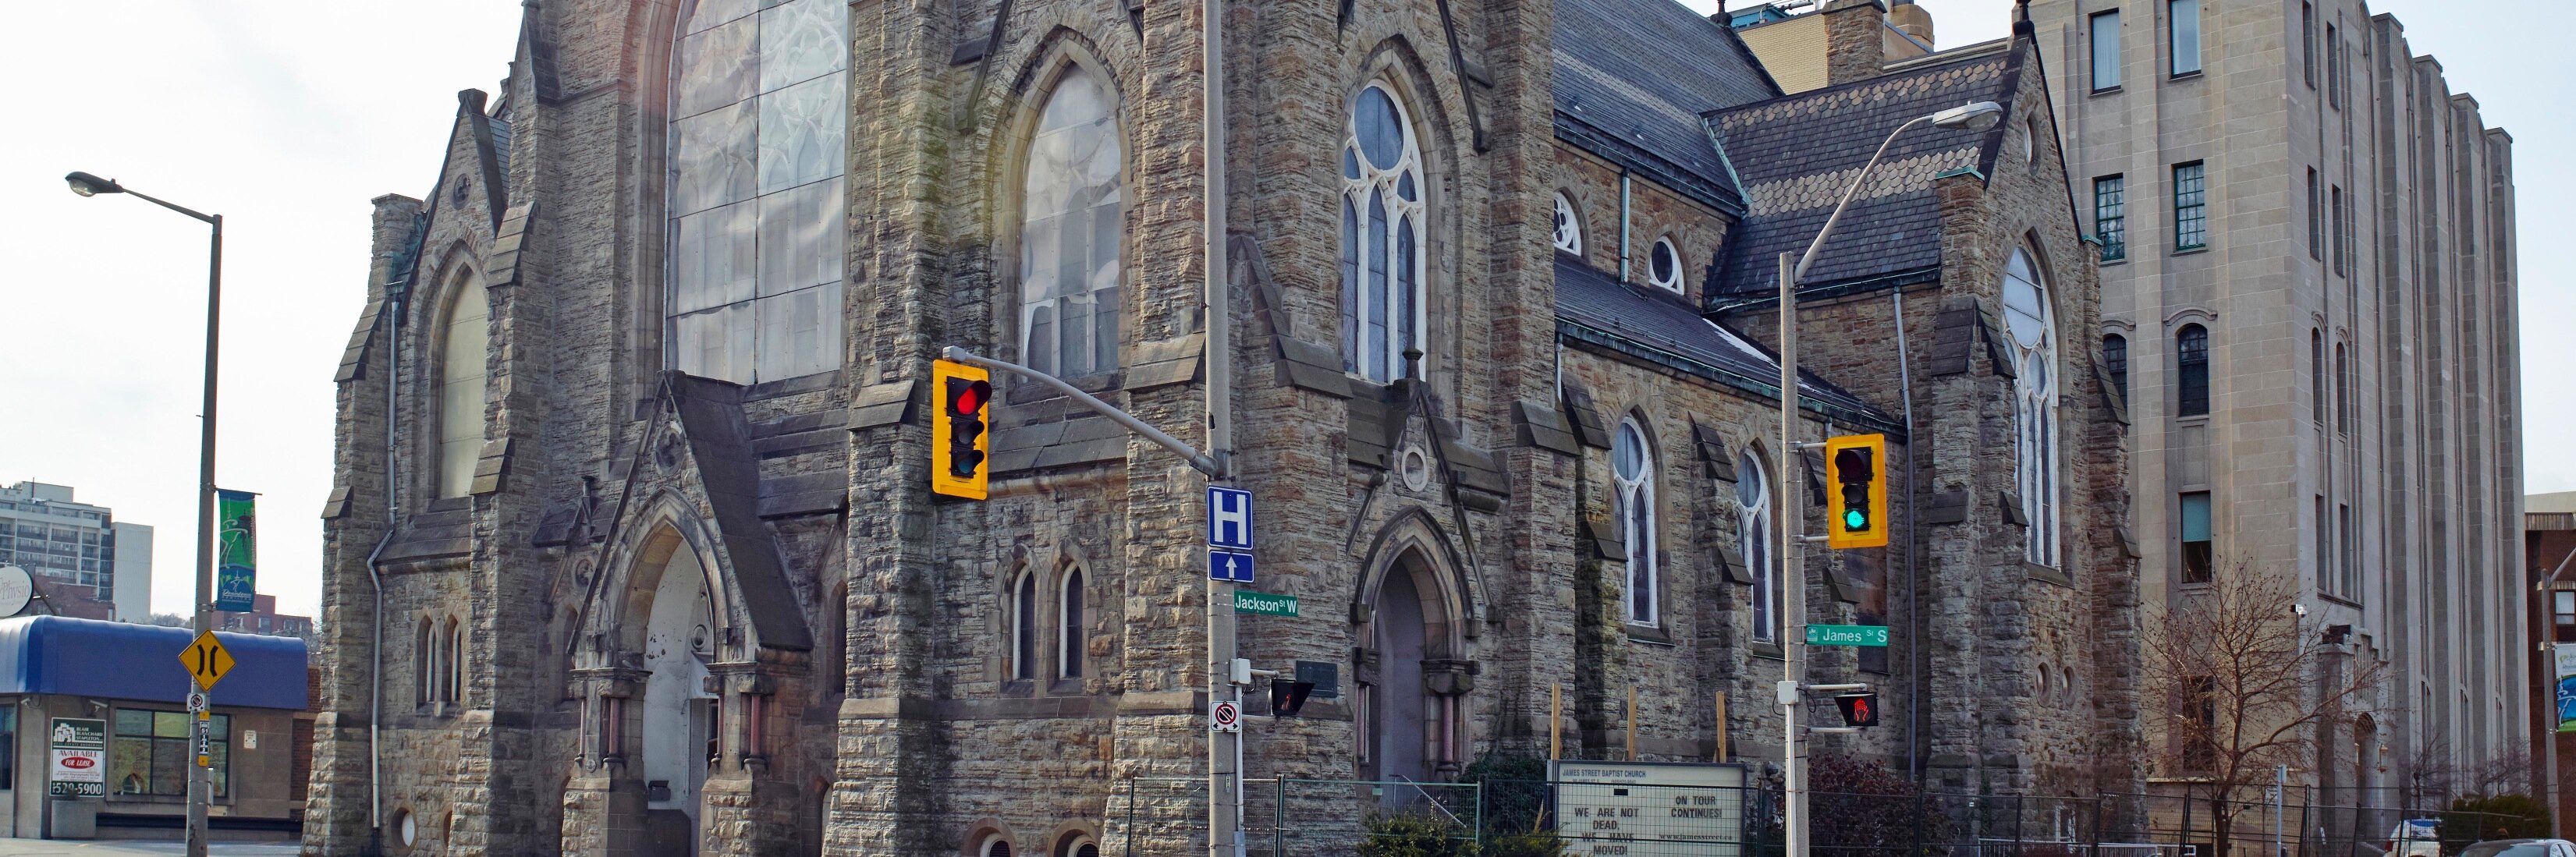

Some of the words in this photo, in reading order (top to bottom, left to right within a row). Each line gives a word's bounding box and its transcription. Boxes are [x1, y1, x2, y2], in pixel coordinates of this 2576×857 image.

[1213, 490, 1247, 545] H
[1235, 595, 1279, 611] Jackson
[1286, 600, 1297, 613] W
[1822, 628, 1862, 642] James
[1877, 629, 1887, 643] S
[1624, 770, 1646, 778] CHURCH
[1675, 796, 1687, 805] ON
[1693, 796, 1716, 805] TOUR
[1574, 807, 1589, 817] WE
[1597, 807, 1616, 817] ARE
[1620, 808, 1640, 818] NOT
[1671, 808, 1723, 818] CONTINUES!
[1582, 832, 1597, 842] WE
[1609, 832, 1634, 843] HAVE
[1593, 845, 1628, 855] MOVED!
